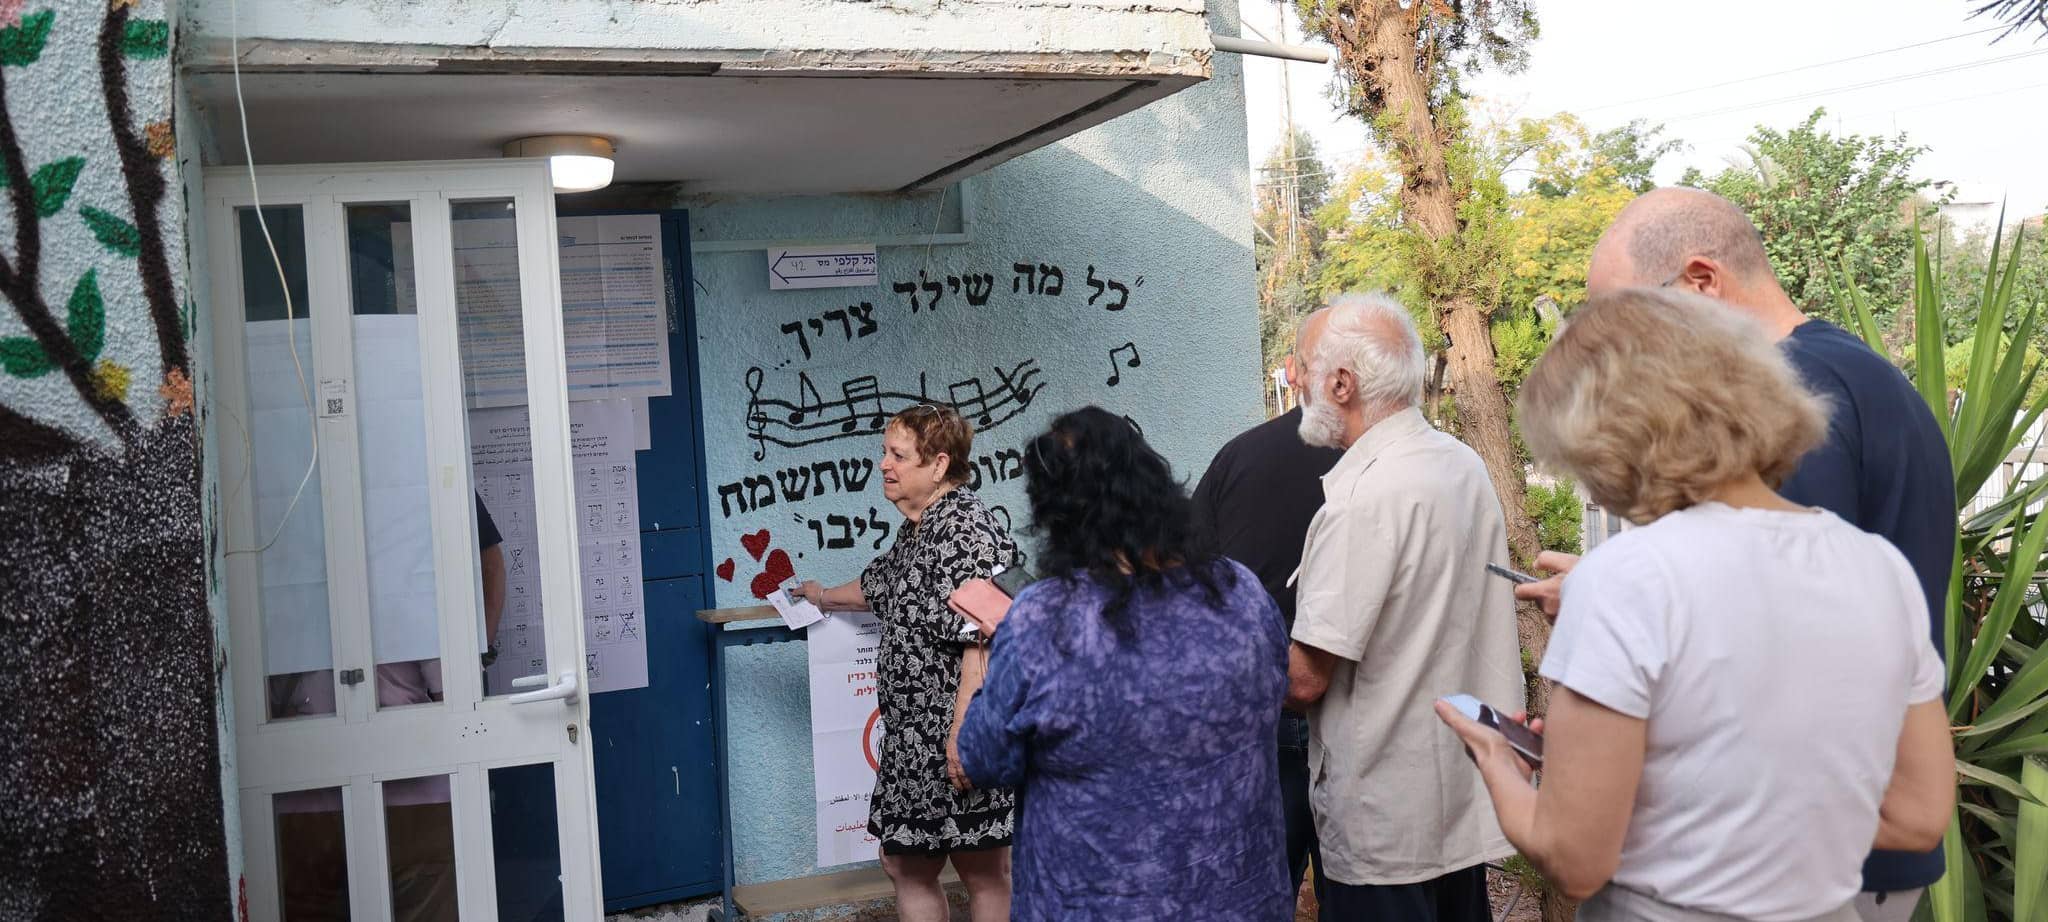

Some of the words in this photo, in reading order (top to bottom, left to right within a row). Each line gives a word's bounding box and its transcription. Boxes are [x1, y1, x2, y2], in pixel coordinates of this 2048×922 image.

[834, 256, 859, 267] קלפי
[863, 255, 876, 264] אל
[1012, 262, 1064, 298] מה
[717, 456, 874, 519] שתשמח
[594, 615, 609, 624] צדק
[856, 646, 873, 654] מותר
[848, 672, 866, 683] כדין
